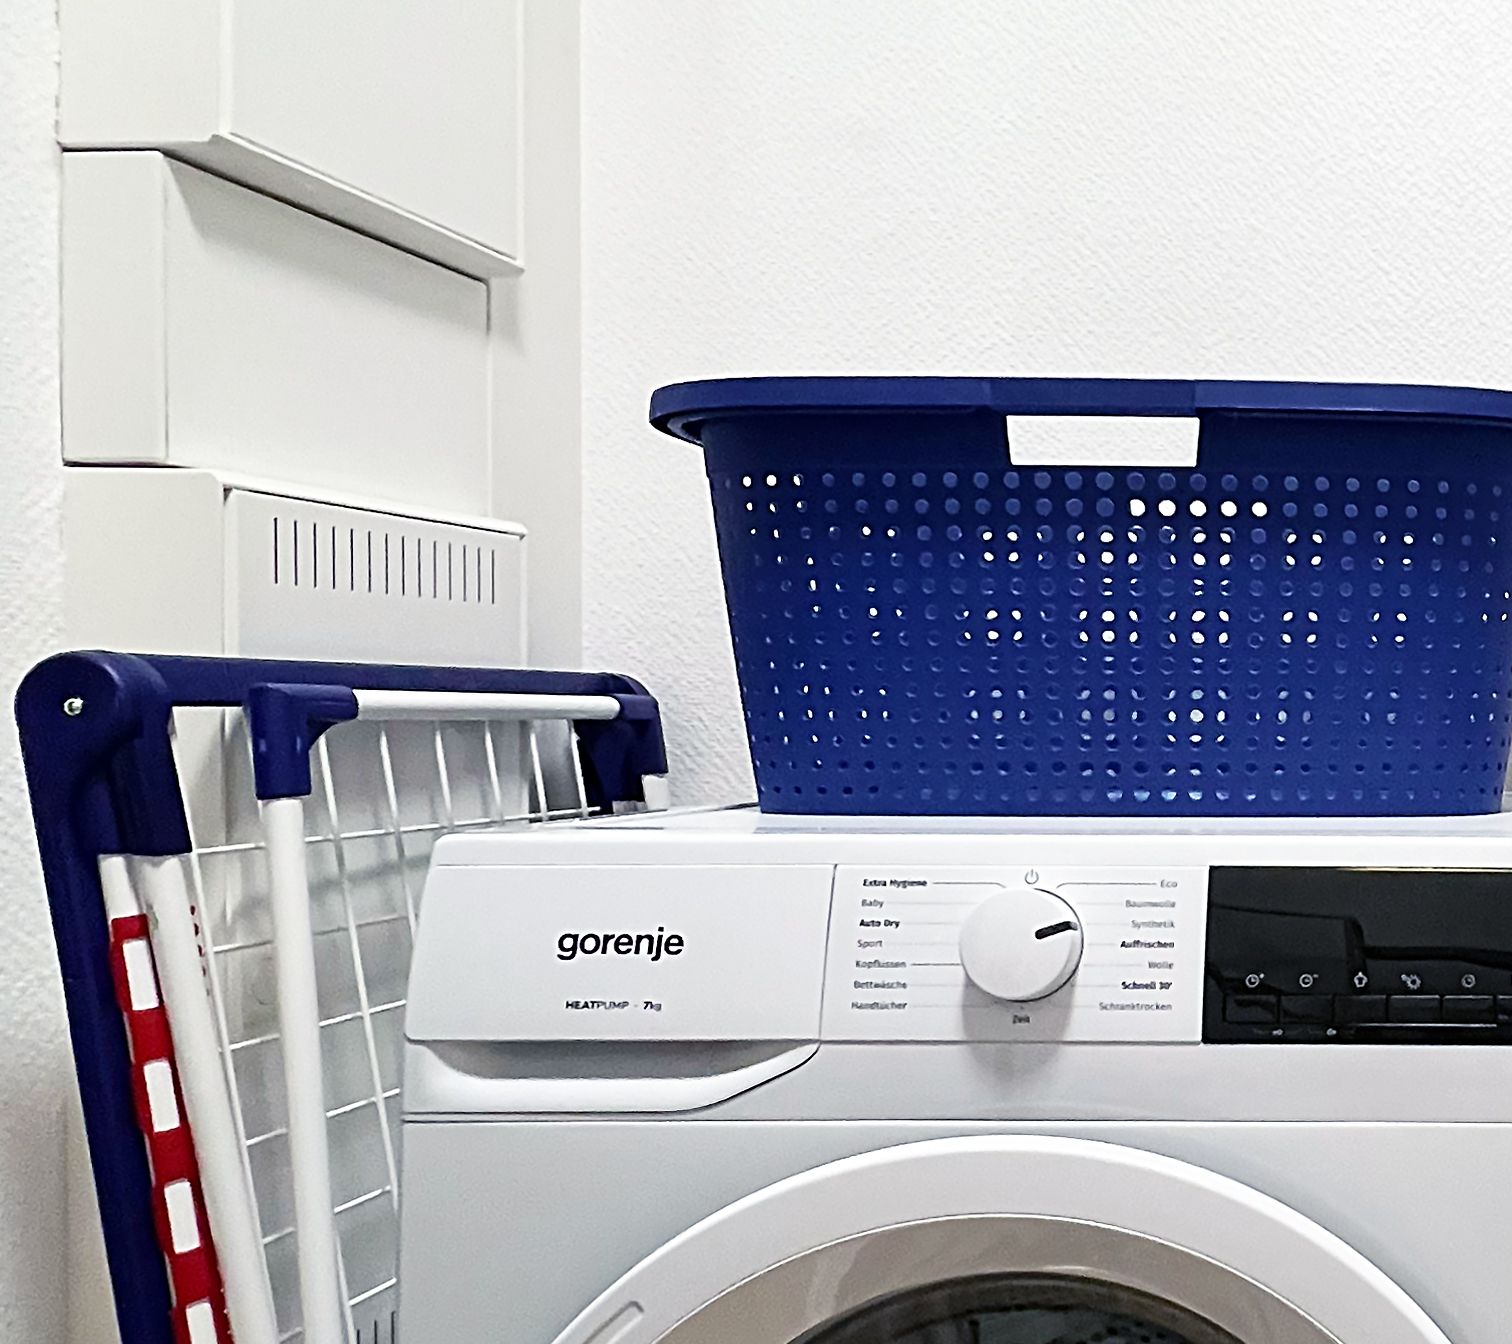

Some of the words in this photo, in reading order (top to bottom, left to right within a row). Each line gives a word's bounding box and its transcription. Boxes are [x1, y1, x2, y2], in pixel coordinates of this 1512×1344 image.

[1160, 879, 1178, 888] Eco
[861, 899, 884, 908] Baby
[859, 919, 881, 927] Auto
[884, 919, 900, 928] Dry
[557, 926, 684, 961] gorenje
[857, 939, 882, 948] Sport
[565, 1000, 630, 1010] HEATPUMP
